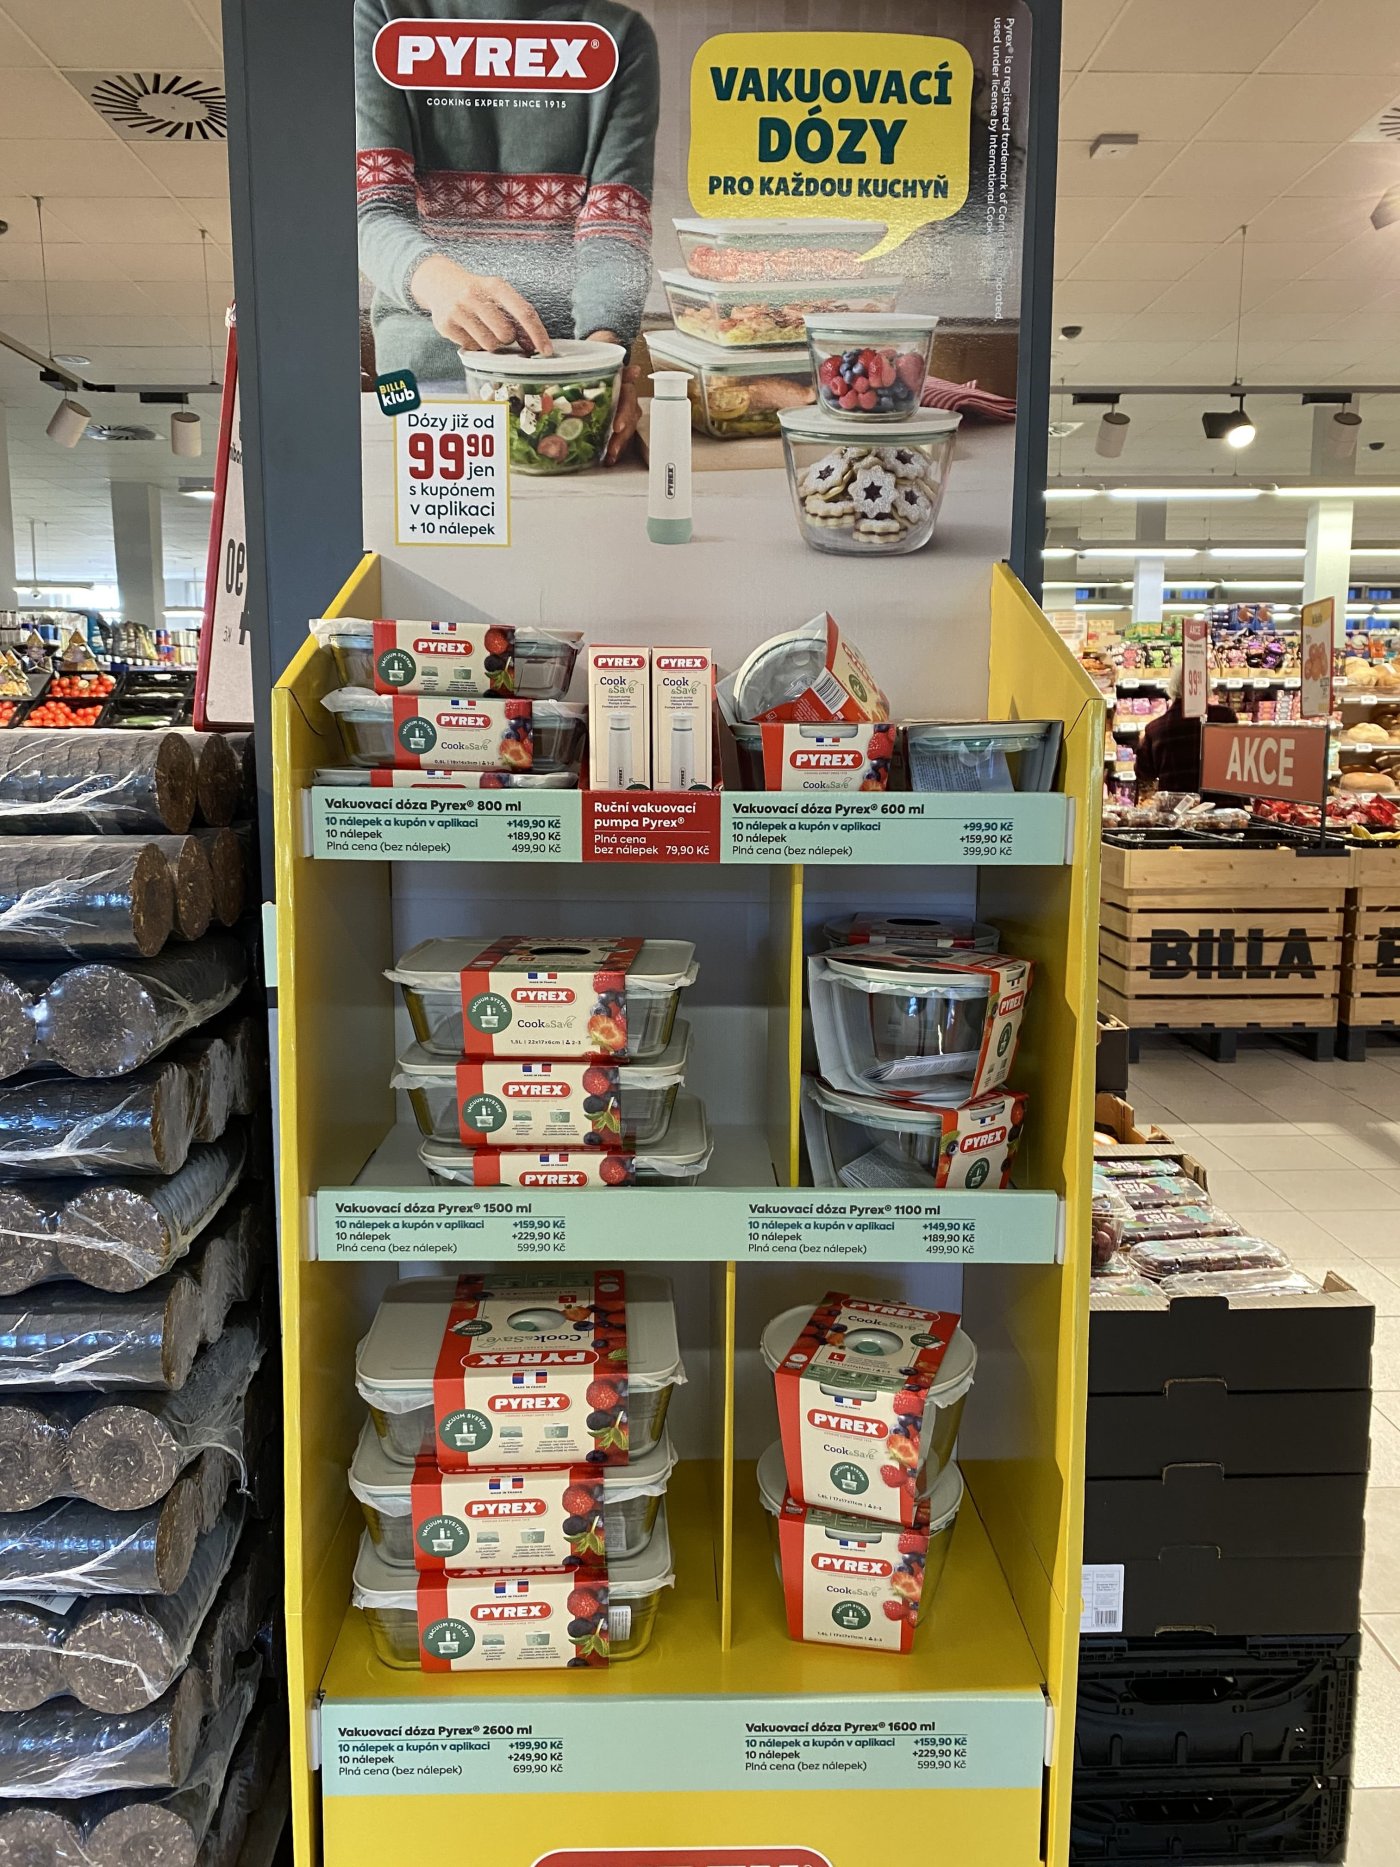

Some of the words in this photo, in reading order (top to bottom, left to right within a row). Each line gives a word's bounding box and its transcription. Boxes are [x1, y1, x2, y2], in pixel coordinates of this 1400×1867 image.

[994, 17, 1002, 43] used
[992, 45, 1001, 77] under
[710, 61, 953, 105] VAKUOVACÍ
[427, 98, 472, 107] COOKING
[475, 98, 510, 107] EXPERT
[513, 99, 541, 108] SINCE
[544, 100, 567, 109] 1915
[990, 79, 1000, 117] license
[1002, 76, 1012, 131] registered
[988, 119, 999, 132] by
[758, 105, 908, 165] DÓZY
[999, 133, 1010, 190] trademark
[987, 134, 998, 204] International
[709, 176, 754, 195] PRO
[760, 172, 852, 197] KAŽDOU
[857, 175, 948, 199] KUCHYŇ
[1000, 192, 1008, 205] of
[379, 380, 407, 394] BILLA
[381, 388, 415, 407] klub
[408, 413, 448, 431] Dózy
[451, 414, 469, 432] již
[474, 415, 494, 429] od
[467, 462, 495, 480] jen
[409, 486, 416, 496] s
[421, 483, 495, 500] kupónem
[410, 503, 420, 515] v
[425, 501, 495, 519] aplikaci
[421, 523, 435, 534] 10
[440, 523, 495, 537] nálepek
[417, 642, 468, 654] PYREX
[598, 658, 640, 667] PYREX
[661, 658, 703, 668] PYREX
[600, 676, 626, 686] Cook
[441, 716, 486, 727] PYREX
[796, 754, 858, 767] PYREX
[1226, 736, 1295, 787] AKCE
[325, 799, 393, 810] Vakuovací
[396, 799, 427, 810] dóza
[431, 801, 474, 813] Pyrex®
[477, 801, 502, 812] 800
[505, 801, 522, 812] ml
[594, 802, 630, 813] Ruční
[631, 803, 696, 814] vakuovací
[733, 803, 798, 814] Vakuovací
[801, 804, 831, 814] dóza
[835, 804, 878, 816] Pyrex®
[881, 805, 905, 814] 600
[909, 804, 925, 814] ml
[325, 817, 337, 826] 10
[339, 817, 383, 827] nálepek
[394, 818, 427, 828] kupón
[438, 818, 479, 829] aplikaci
[506, 820, 546, 831] +149,90
[548, 819, 561, 829] Kč
[594, 818, 639, 829] pumpa
[642, 817, 685, 828] Pyrex®
[325, 830, 338, 838] 10
[340, 830, 383, 840] nálepek
[507, 832, 546, 843] +189,90
[548, 831, 561, 841] Kč
[595, 835, 617, 844] Plná
[327, 842, 349, 851] Plná
[380, 842, 403, 853] (bez
[405, 842, 451, 854] nálepek)
[512, 844, 546, 855] 499,90
[548, 843, 561, 853] Kč
[595, 845, 614, 855] bez
[616, 845, 659, 856] nálepek
[666, 846, 694, 856] 79,90
[697, 845, 710, 855] Kč
[1150, 928, 1317, 980] BILLA
[516, 991, 568, 1001] PYREX
[471, 996, 490, 1013] VACUUM
[489, 996, 509, 1013] SYSTEM
[1001, 995, 1023, 1013] PYREX
[508, 1085, 563, 1096] PYREX
[963, 1130, 1002, 1151] PYREX
[524, 1174, 580, 1186] PYREX
[335, 1203, 401, 1213] Vakuovací
[404, 1203, 435, 1213] dóza
[438, 1203, 481, 1215] Pyrex®
[483, 1203, 513, 1213] 1500
[516, 1203, 532, 1213] ml
[749, 1204, 814, 1214] Vakuovací
[816, 1204, 846, 1215] dóza
[850, 1205, 892, 1217] Pyrex®
[895, 1206, 922, 1215] 1100
[925, 1206, 941, 1215] ml
[850, 1301, 930, 1320] PYREX
[479, 1352, 586, 1364] PYREX
[495, 1397, 560, 1409] PYREX
[444, 1413, 465, 1431] VACUUM
[466, 1413, 487, 1430] SYSTEM
[814, 1413, 880, 1435] PYREX
[472, 1502, 537, 1515] PYREX
[818, 1557, 884, 1575] PYREX
[477, 1606, 541, 1618] PYREX
[338, 1726, 402, 1737] Vakuovací
[405, 1726, 435, 1736] dóza
[439, 1726, 480, 1738] Pyrex®
[483, 1726, 514, 1735] 2600
[517, 1725, 533, 1735] ml
[746, 1723, 809, 1733] Vakuovací
[811, 1723, 841, 1733] dóza
[844, 1722, 886, 1734] Pyrex®
[888, 1722, 918, 1732] 1600
[920, 1722, 936, 1731] ml
[338, 1744, 350, 1752] 10
[352, 1743, 395, 1753] nálepek
[406, 1742, 439, 1753] kupón
[450, 1741, 491, 1752] aplikaci
[509, 1741, 548, 1751] +199,90
[550, 1740, 563, 1750] Kč
[339, 1767, 361, 1776] Plná
[364, 1768, 390, 1776] cena
[392, 1766, 415, 1776] (bez
[417, 1765, 463, 1776] nálepek)
[513, 1765, 548, 1774] 699,90
[551, 1764, 564, 1773] Kč
